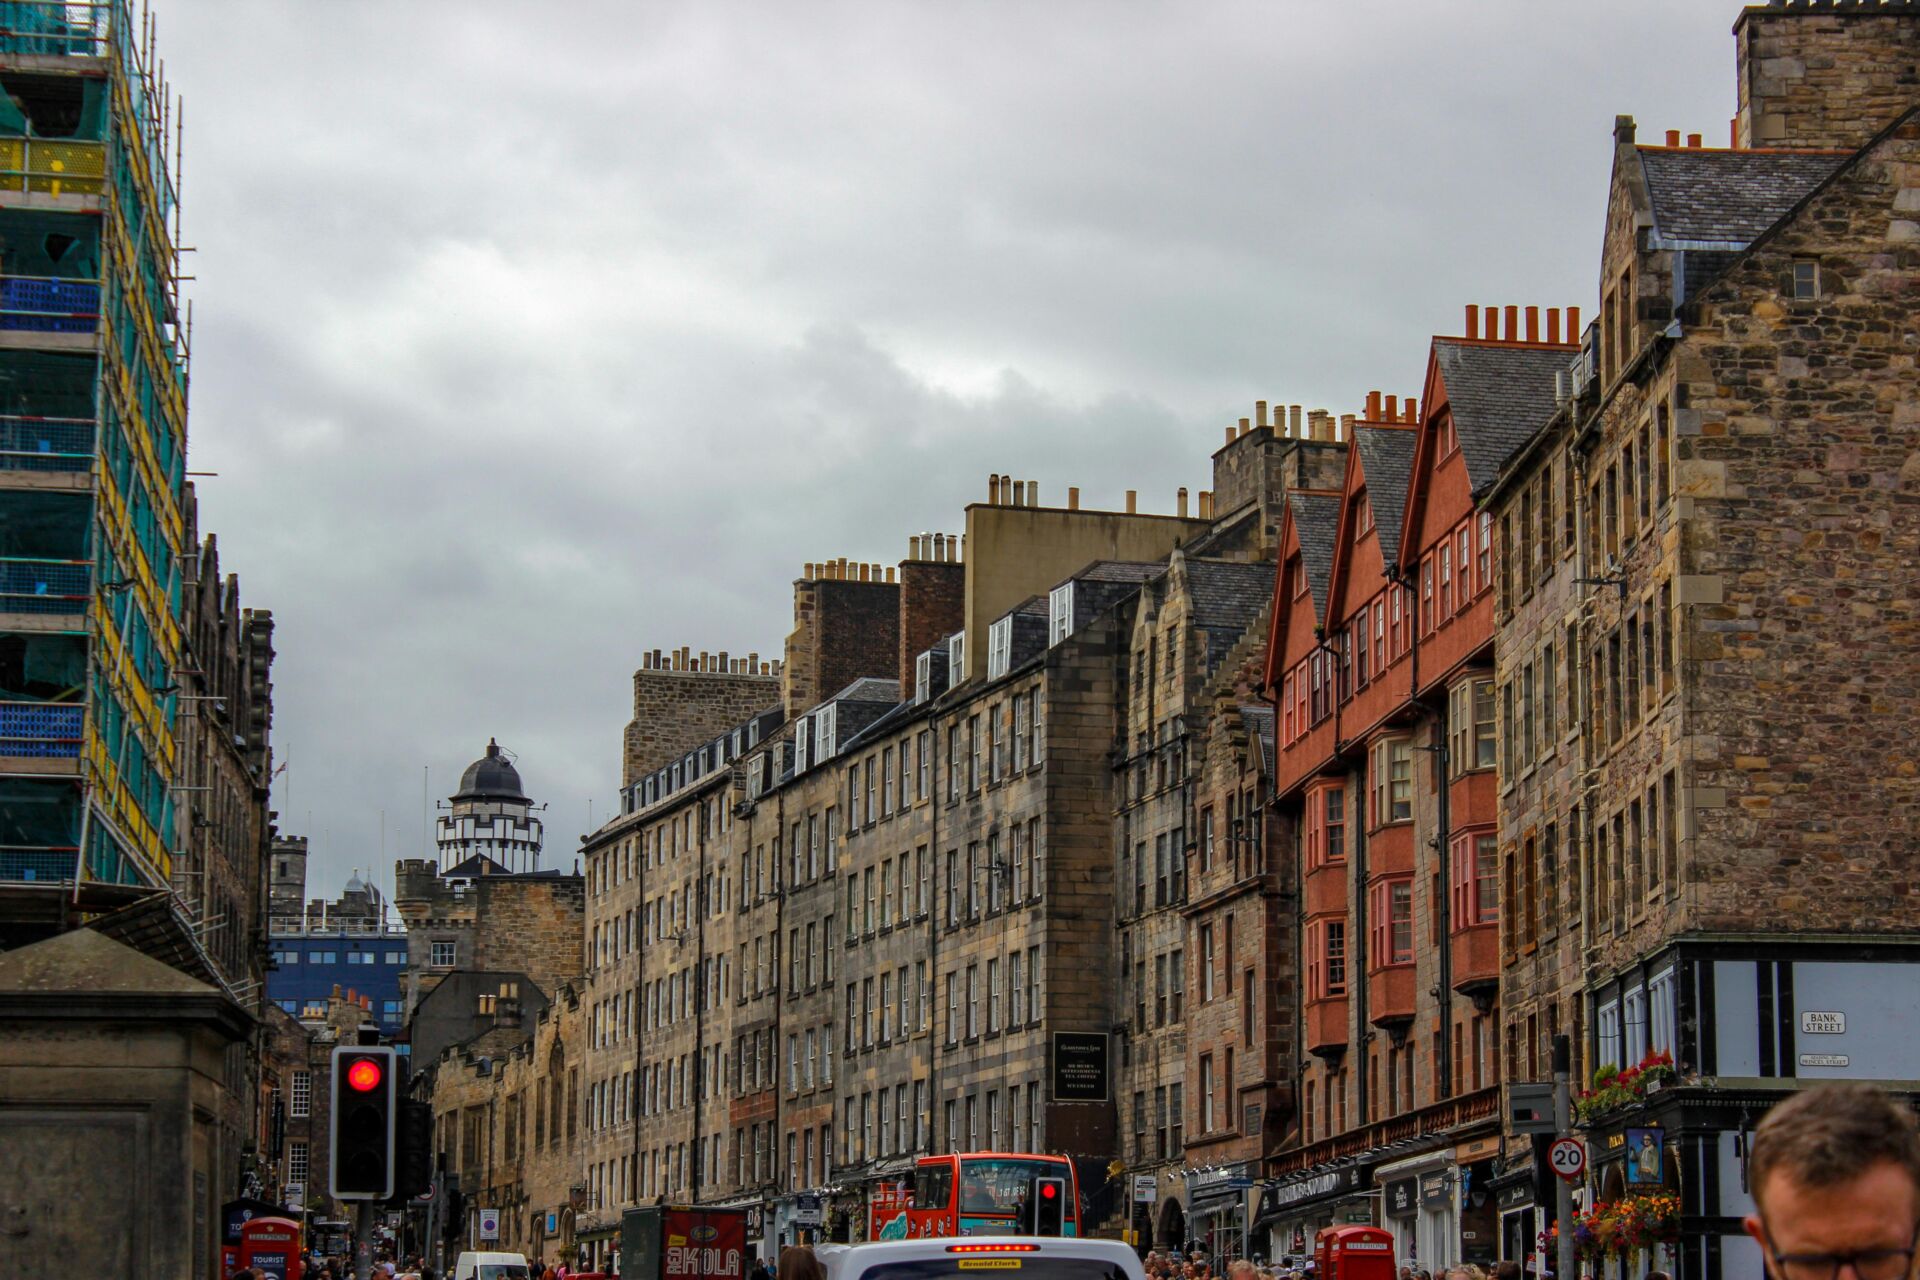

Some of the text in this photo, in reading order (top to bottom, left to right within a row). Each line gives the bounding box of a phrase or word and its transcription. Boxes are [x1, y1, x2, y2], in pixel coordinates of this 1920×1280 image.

[1810, 1013, 1837, 1022] BANK
[1806, 1023, 1842, 1031] STREET
[1554, 1150, 1581, 1166] 20
[252, 1256, 285, 1264] TOURIST
[682, 1247, 740, 1276] KOLA
